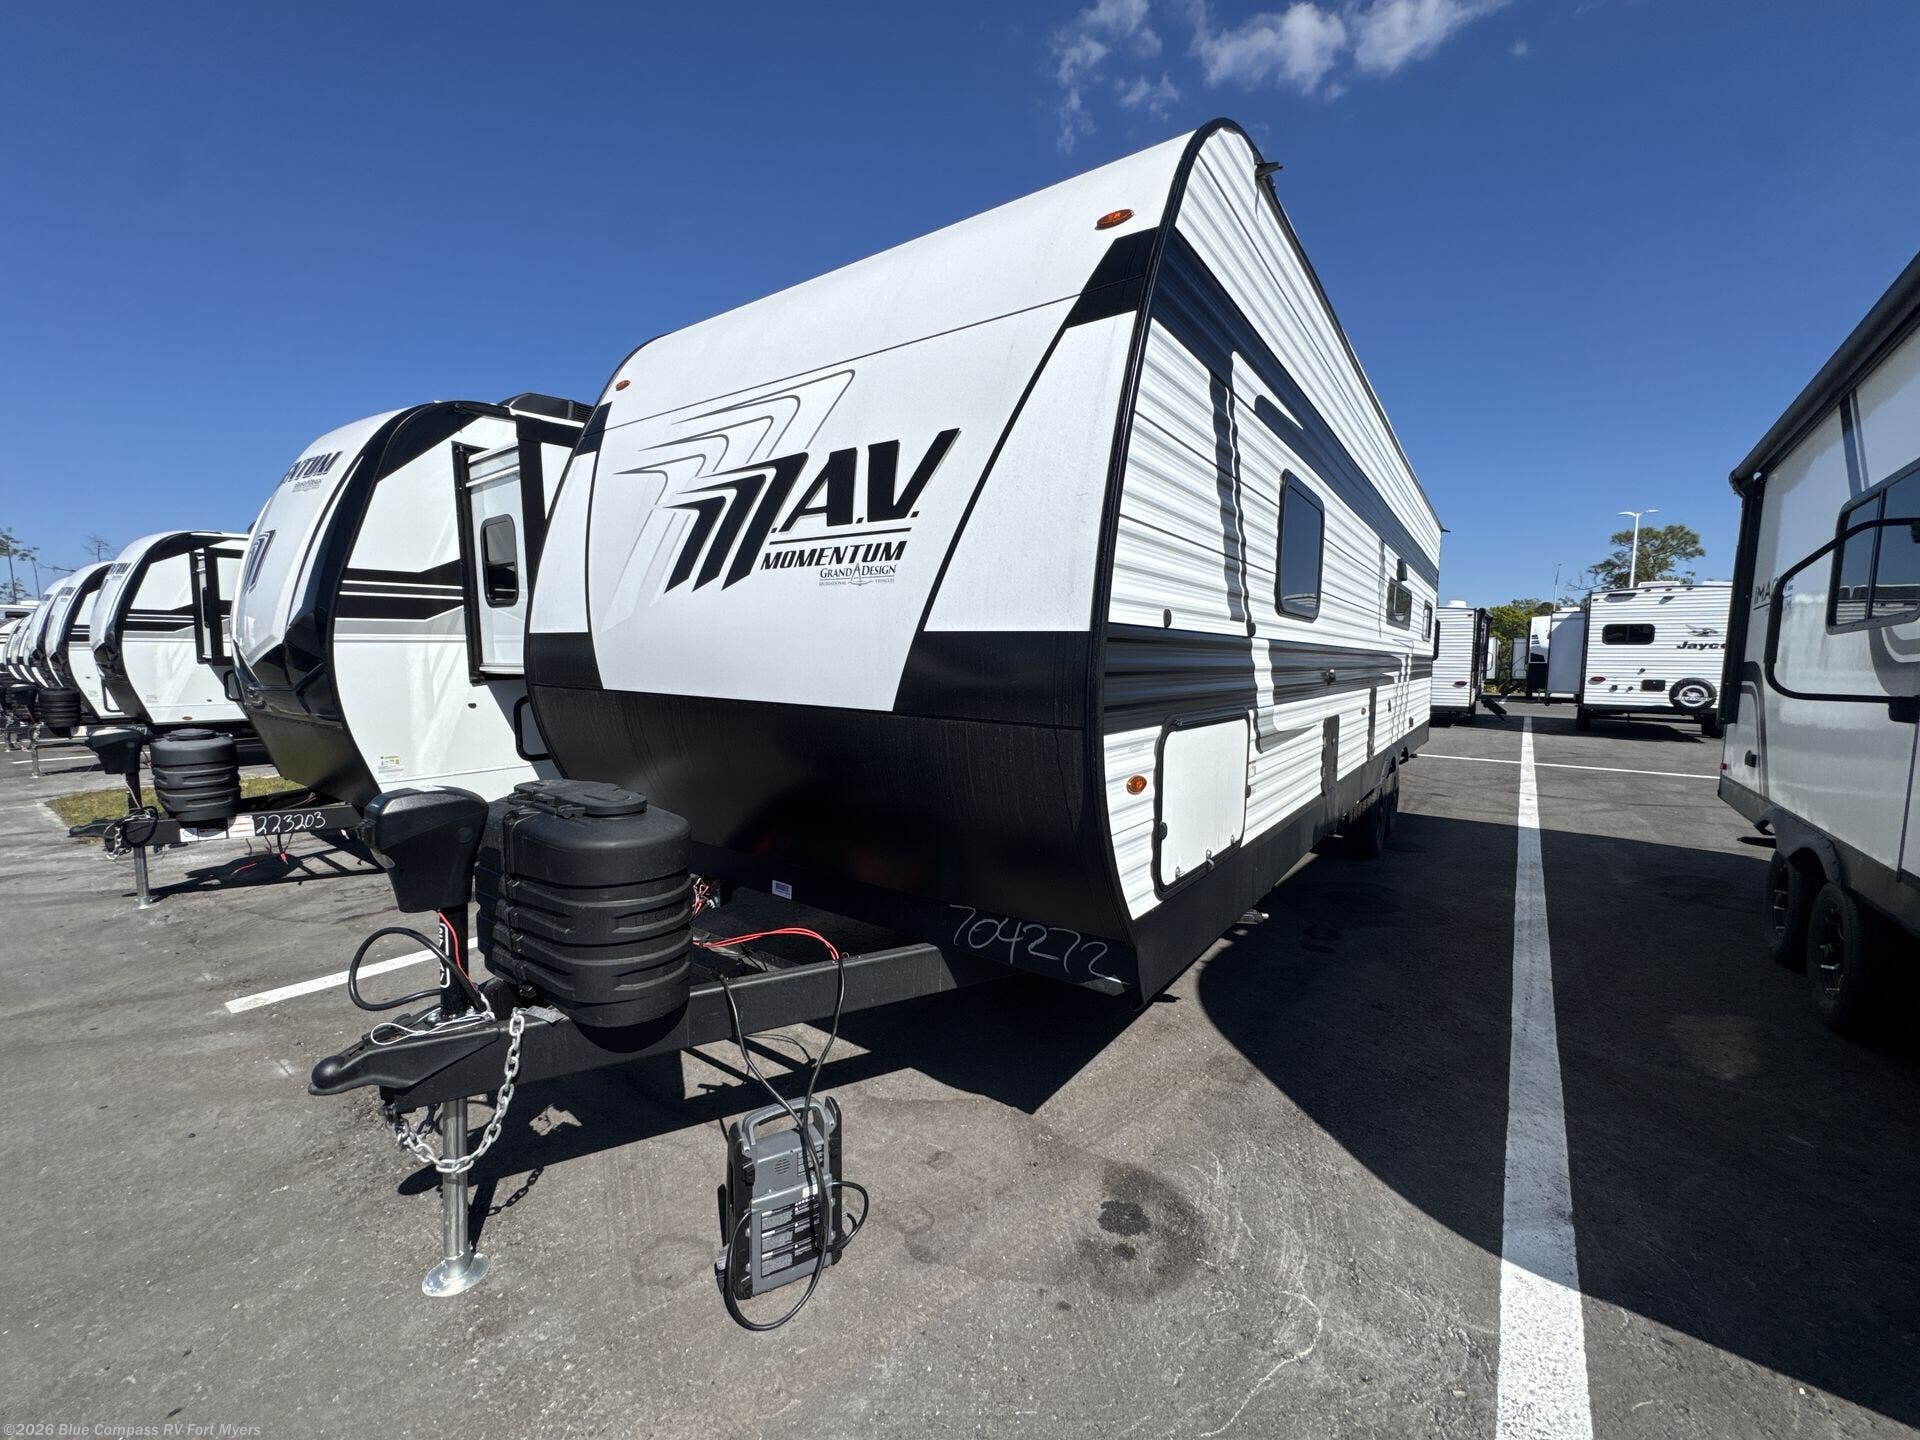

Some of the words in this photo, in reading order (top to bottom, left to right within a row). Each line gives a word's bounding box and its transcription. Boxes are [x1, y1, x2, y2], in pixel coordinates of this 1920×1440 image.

[760, 540, 908, 570] MOMENTUM
[820, 567, 852, 578] GRAND
[862, 563, 897, 576] DESIGN
[255, 811, 326, 834] 223203
[950, 904, 1131, 985] 704272
